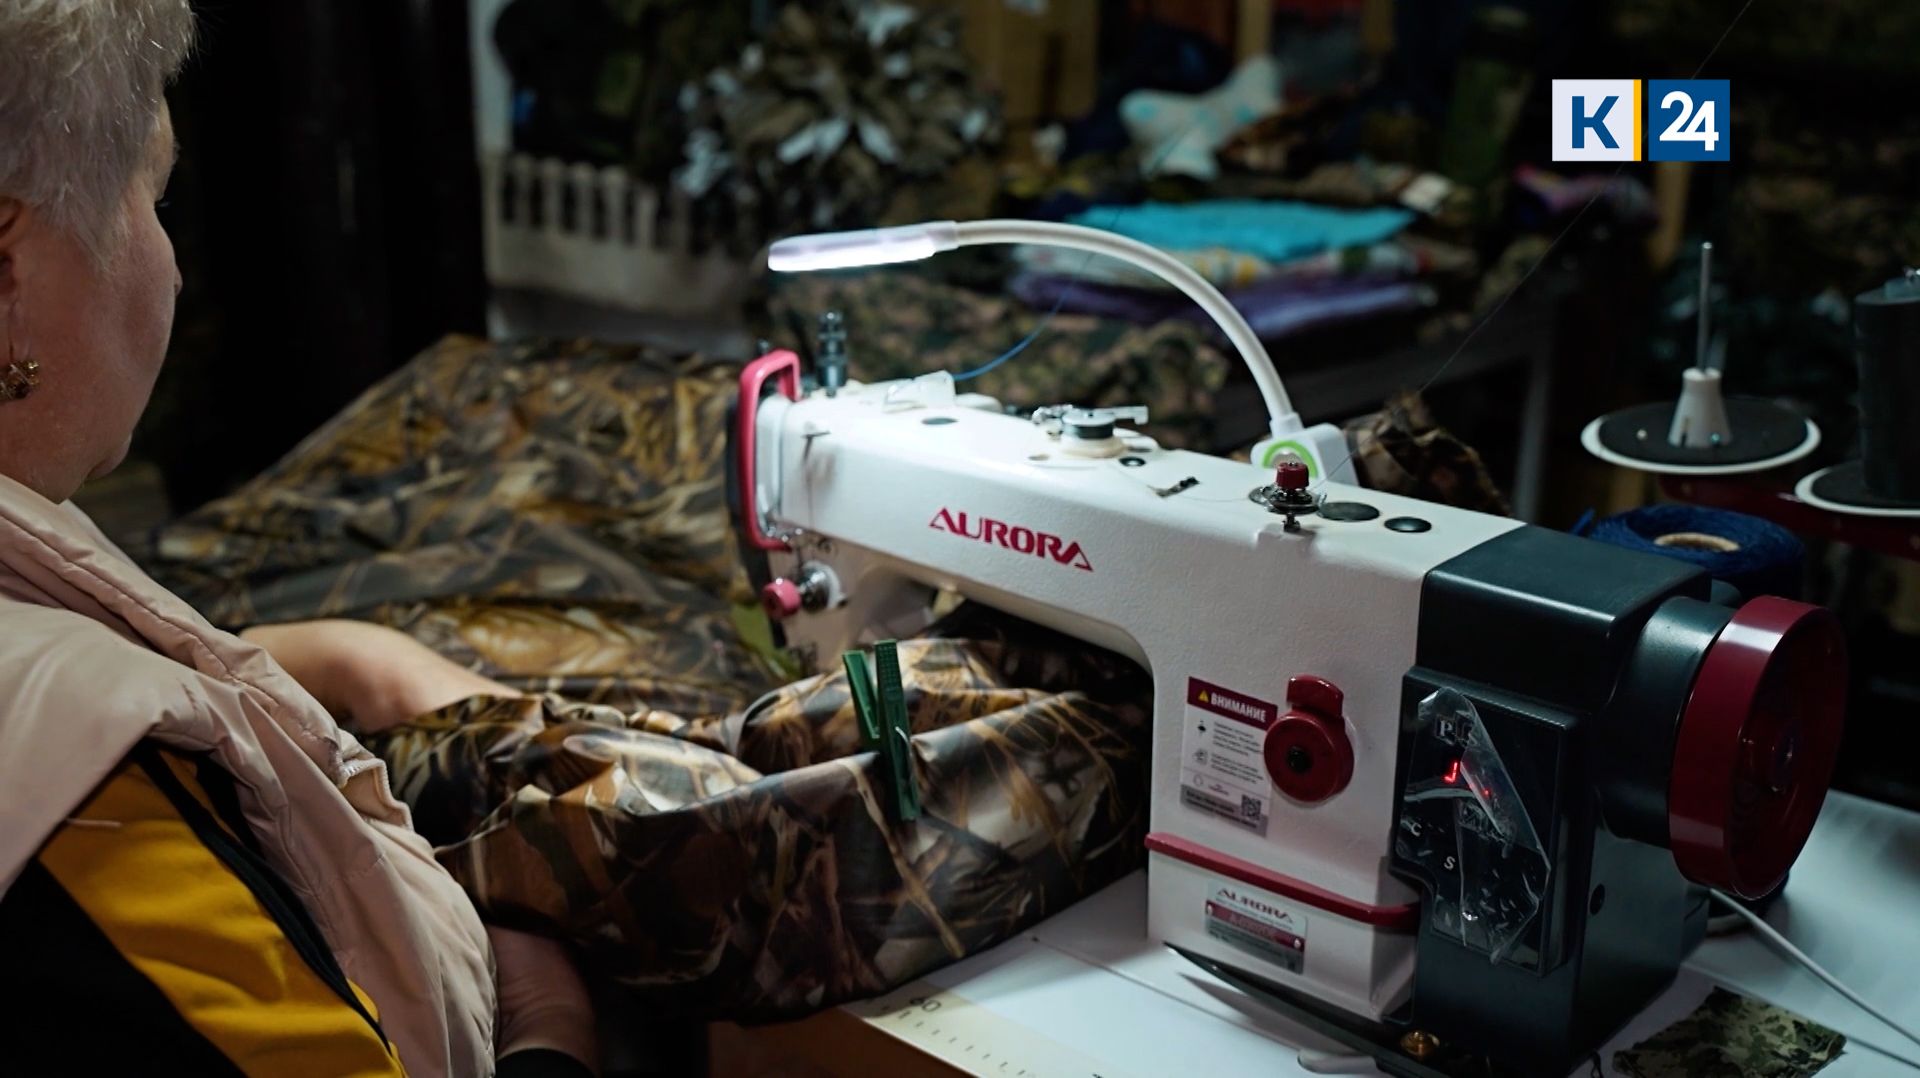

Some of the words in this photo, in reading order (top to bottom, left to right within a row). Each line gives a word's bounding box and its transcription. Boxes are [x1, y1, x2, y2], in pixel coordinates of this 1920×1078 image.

[929, 508, 1093, 572] AURORA
[1210, 692, 1267, 723] ВНИМАНИЕ
[1443, 855, 1456, 871] S
